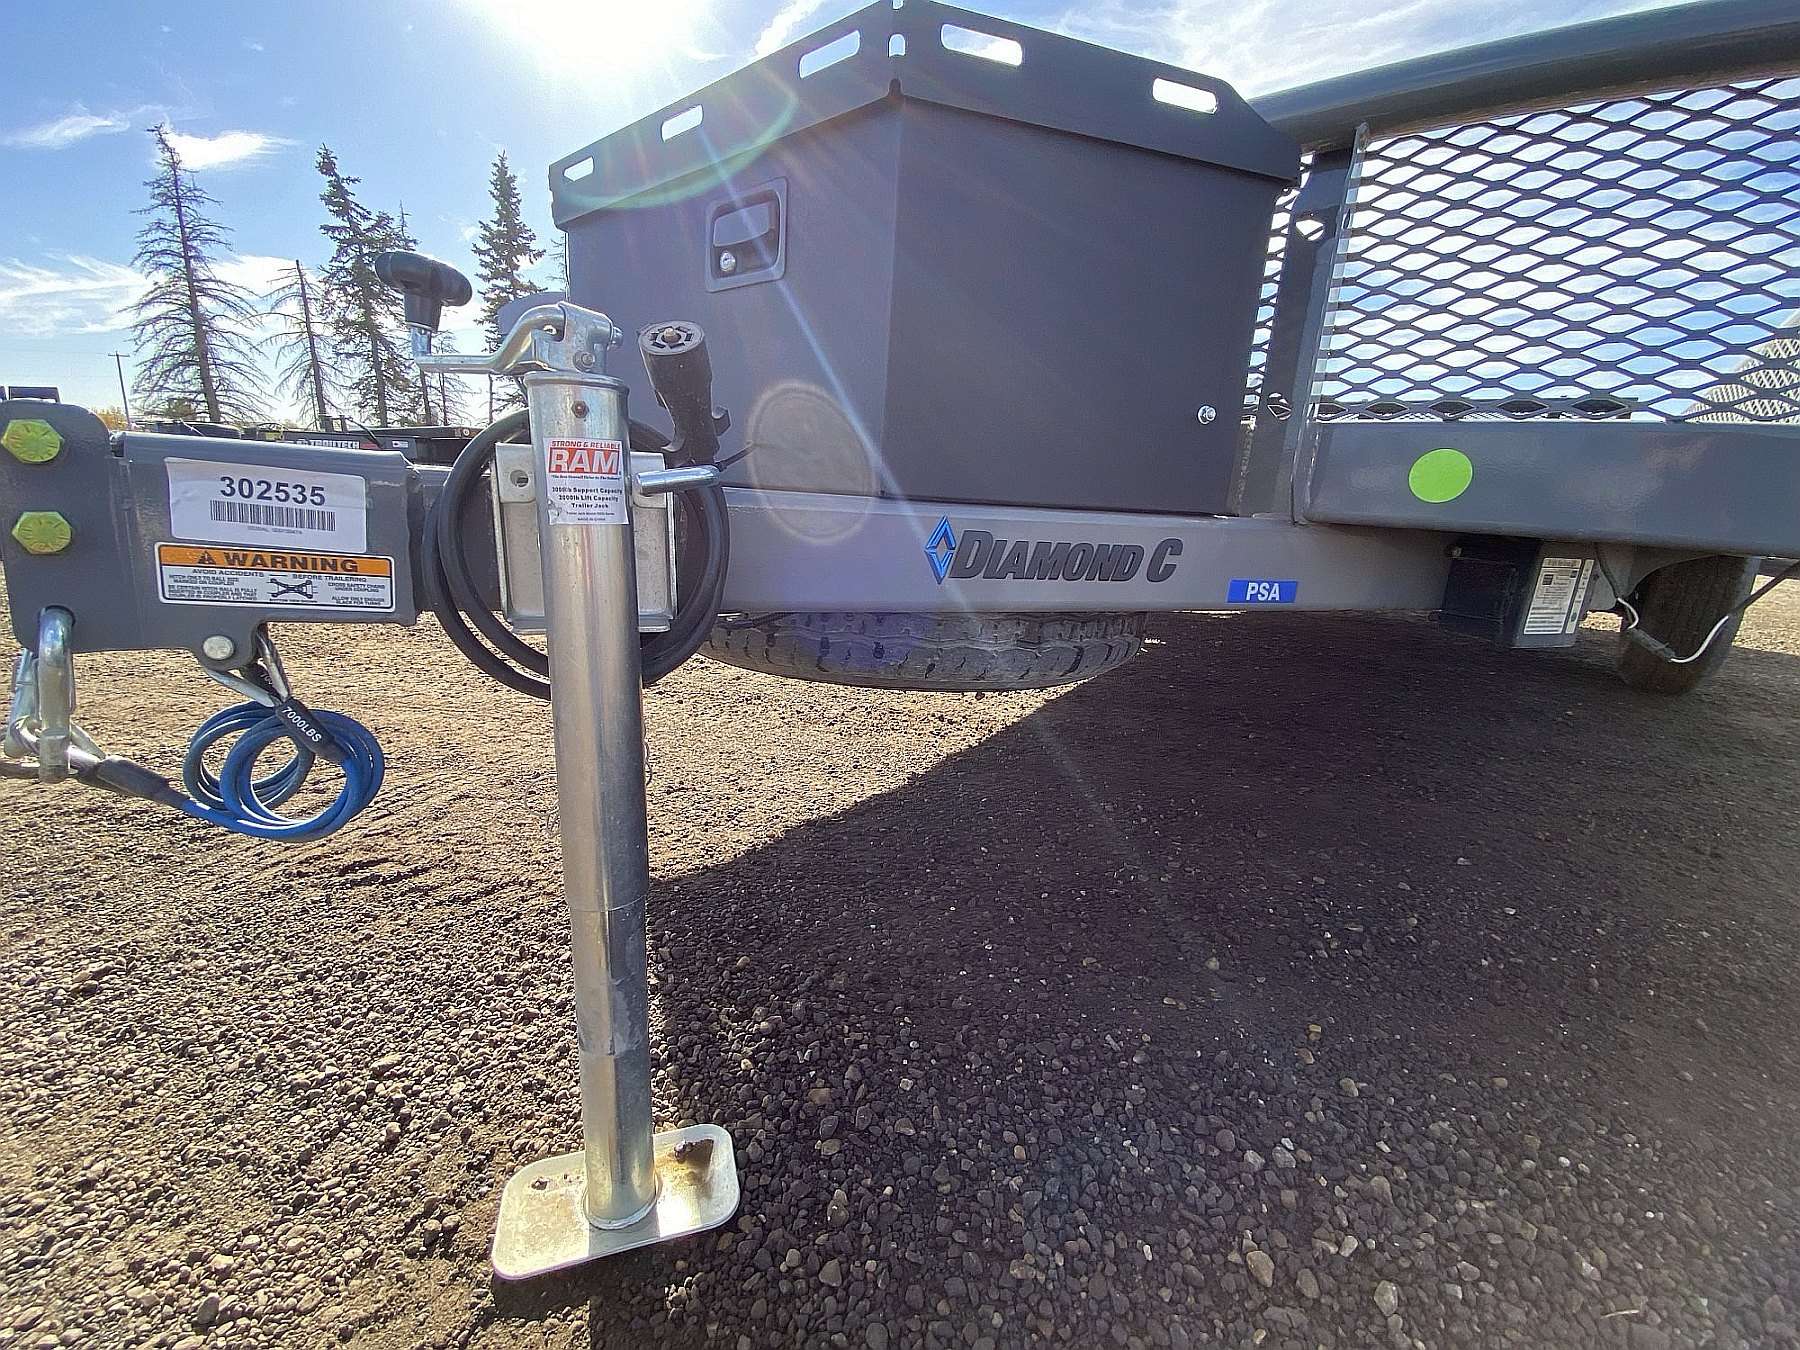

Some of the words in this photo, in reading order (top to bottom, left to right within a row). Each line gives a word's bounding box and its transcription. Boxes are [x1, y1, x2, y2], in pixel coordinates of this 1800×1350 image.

[551, 440, 582, 448] STRONG
[550, 448, 619, 474] RAM
[219, 476, 326, 506] 302535
[600, 487, 623, 495] Capacity
[223, 551, 359, 573] WARNING
[948, 529, 1145, 582] DIAMOND
[1146, 537, 1183, 583] C
[218, 570, 265, 578] ACCIDENTS
[292, 573, 323, 581] BEFORE
[324, 575, 367, 583] TRAILERING
[1245, 582, 1281, 601] PSA
[280, 706, 322, 742] 7000LBS
